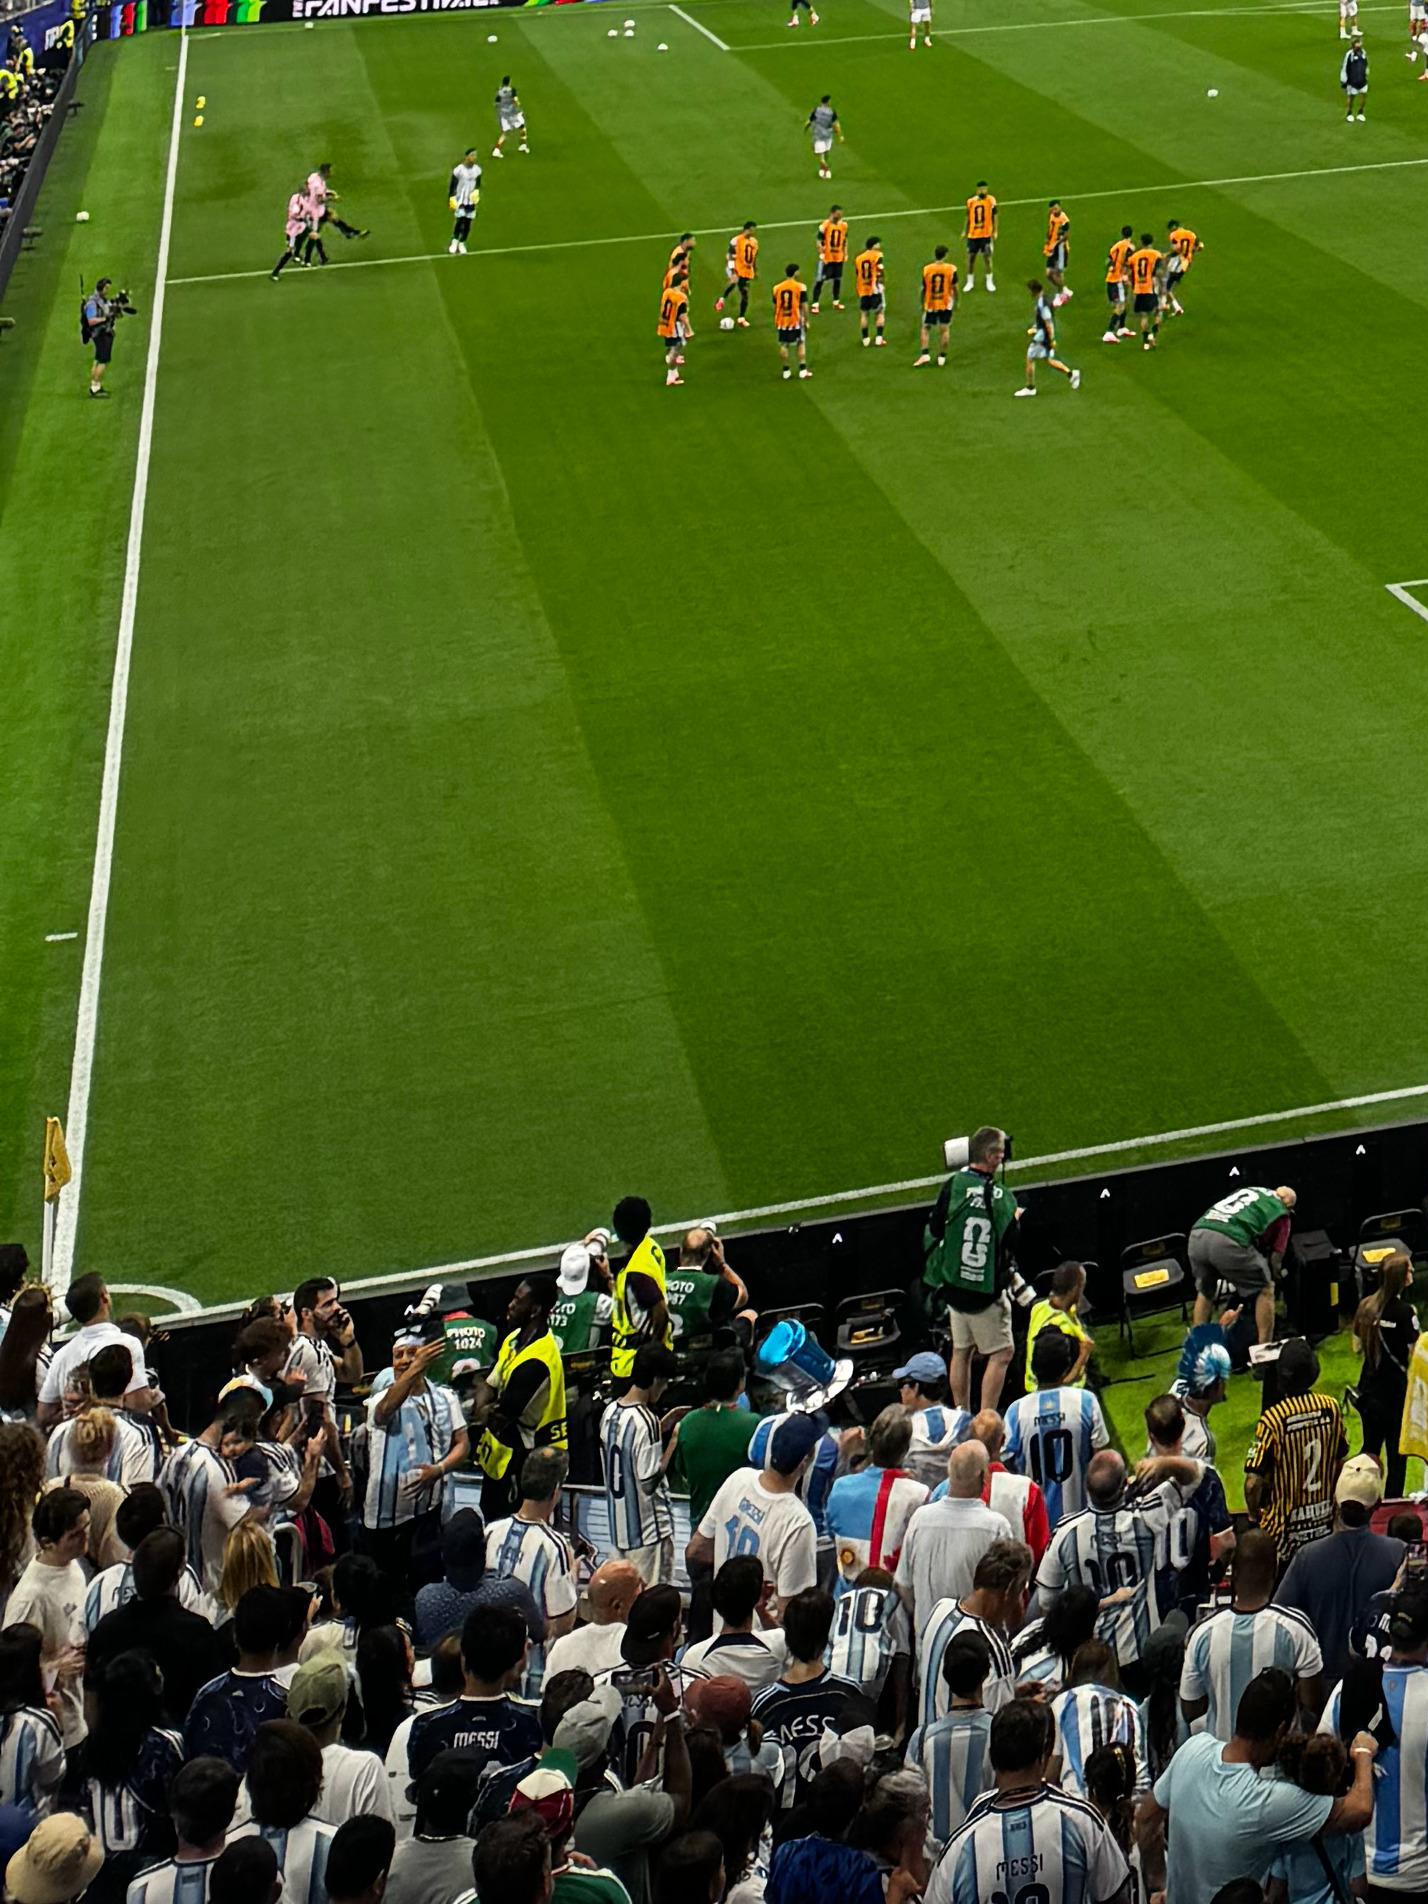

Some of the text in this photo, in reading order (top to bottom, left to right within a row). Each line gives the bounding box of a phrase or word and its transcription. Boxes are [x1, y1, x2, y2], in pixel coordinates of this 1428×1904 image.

[1033, 1412, 1066, 1427] MESSI
[1029, 1429, 1074, 1485] 10
[1301, 1437, 1322, 1492] 2
[837, 1586, 884, 1636] 10
[454, 1730, 500, 1750] MESSI
[995, 1852, 1044, 1882] MESSI
